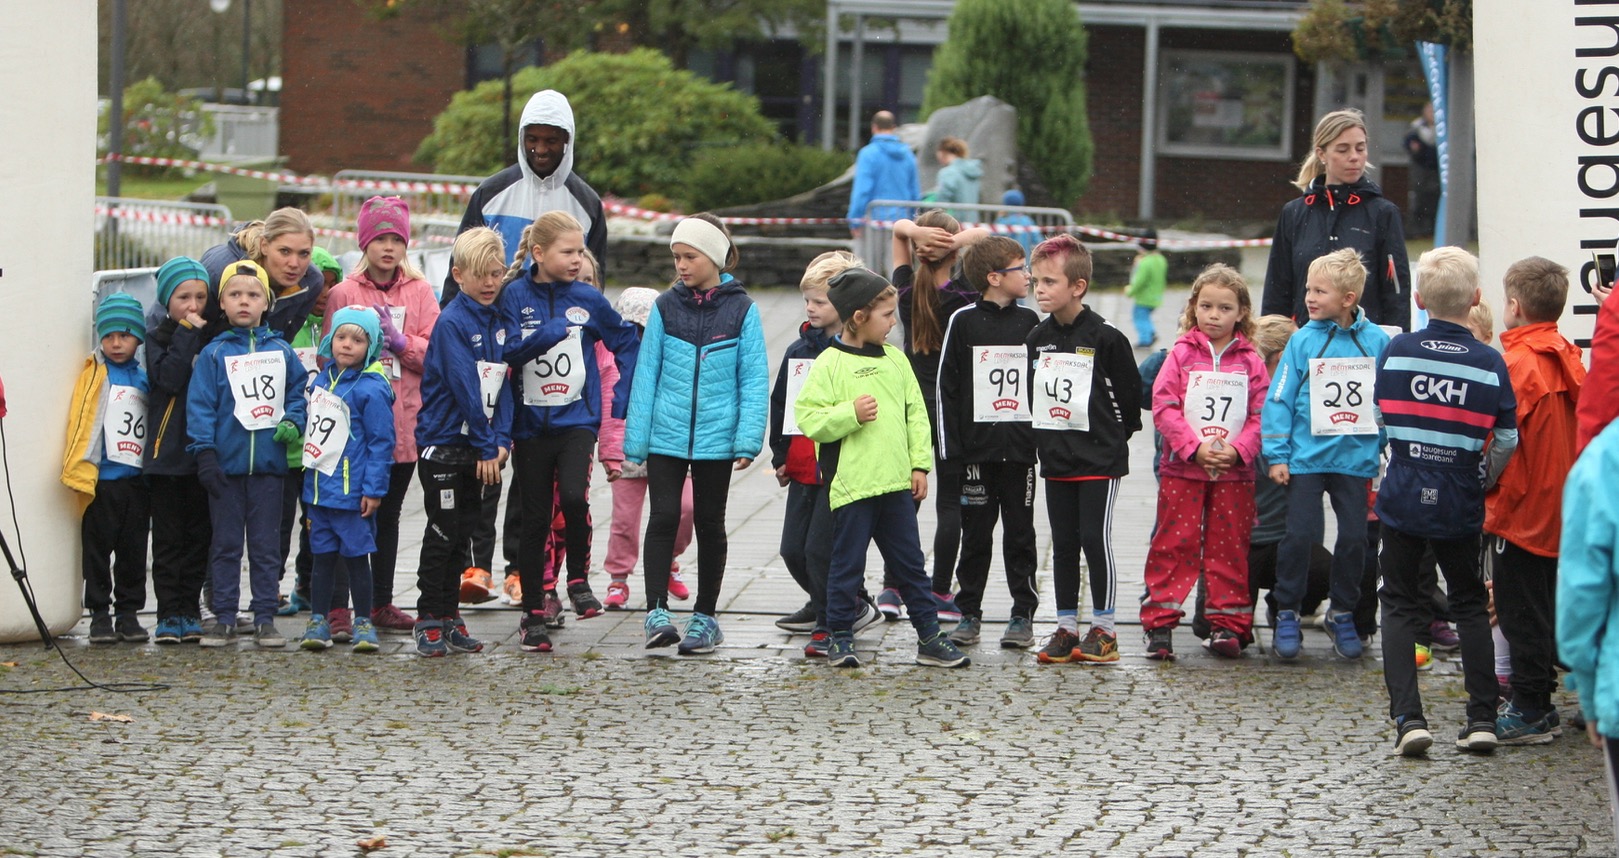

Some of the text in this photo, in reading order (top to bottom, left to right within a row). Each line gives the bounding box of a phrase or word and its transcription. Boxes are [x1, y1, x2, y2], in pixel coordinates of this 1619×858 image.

[534, 353, 571, 378] 50
[241, 375, 275, 400] 48
[543, 385, 568, 394] MENY
[989, 368, 1020, 397] 99
[1045, 377, 1073, 404] 43
[1323, 381, 1362, 408] 28
[995, 401, 1018, 409] MENY
[1051, 409, 1069, 418] MENY
[1201, 396, 1232, 422] 37
[1332, 413, 1356, 422] MENY
[117, 411, 145, 439] 36
[309, 415, 336, 446] 39
[119, 442, 141, 454] MENY
[966, 464, 981, 480] SN
